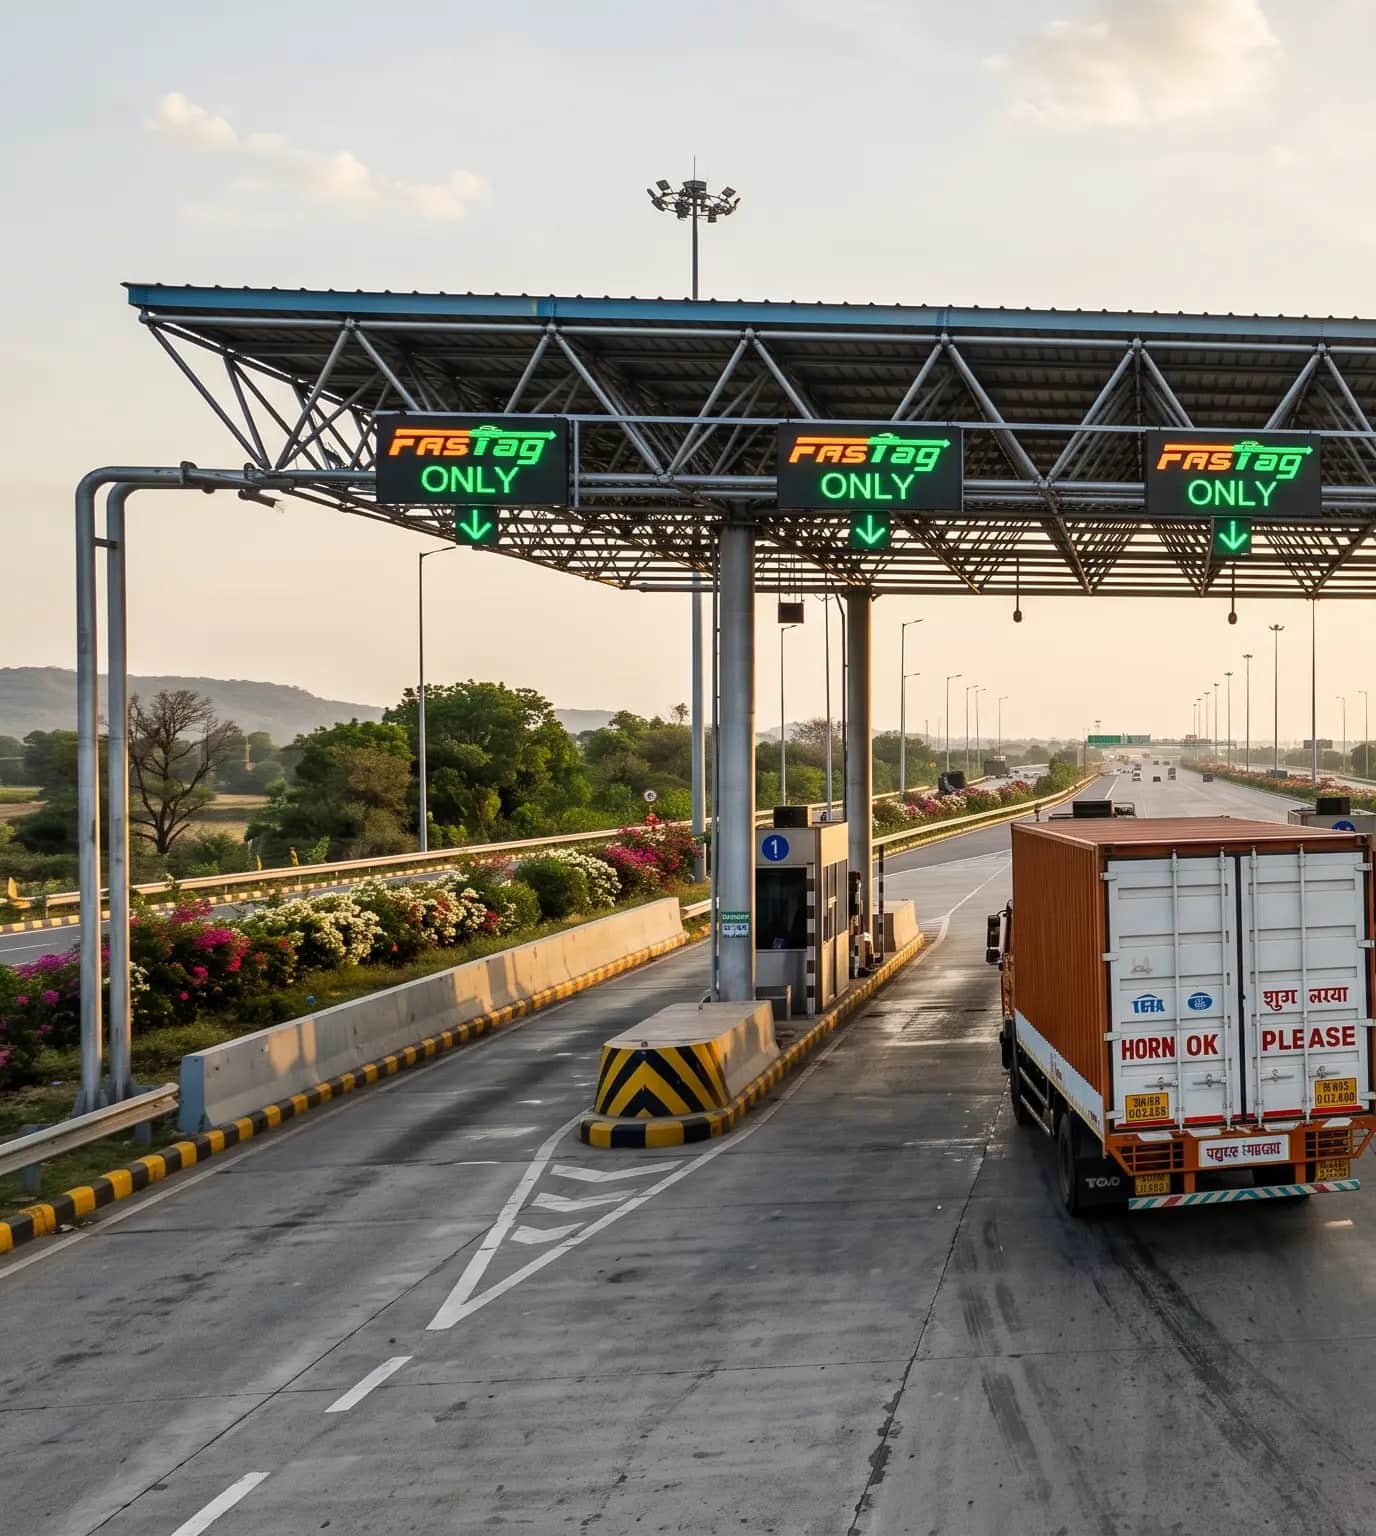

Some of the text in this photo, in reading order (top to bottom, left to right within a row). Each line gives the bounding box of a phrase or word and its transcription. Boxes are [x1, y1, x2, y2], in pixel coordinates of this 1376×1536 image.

[421, 466, 519, 494] ONLY
[820, 473, 915, 500] ONLY
[1187, 480, 1277, 506] ONLY
[1121, 1026, 1356, 1061] HORN OK PLEASE
